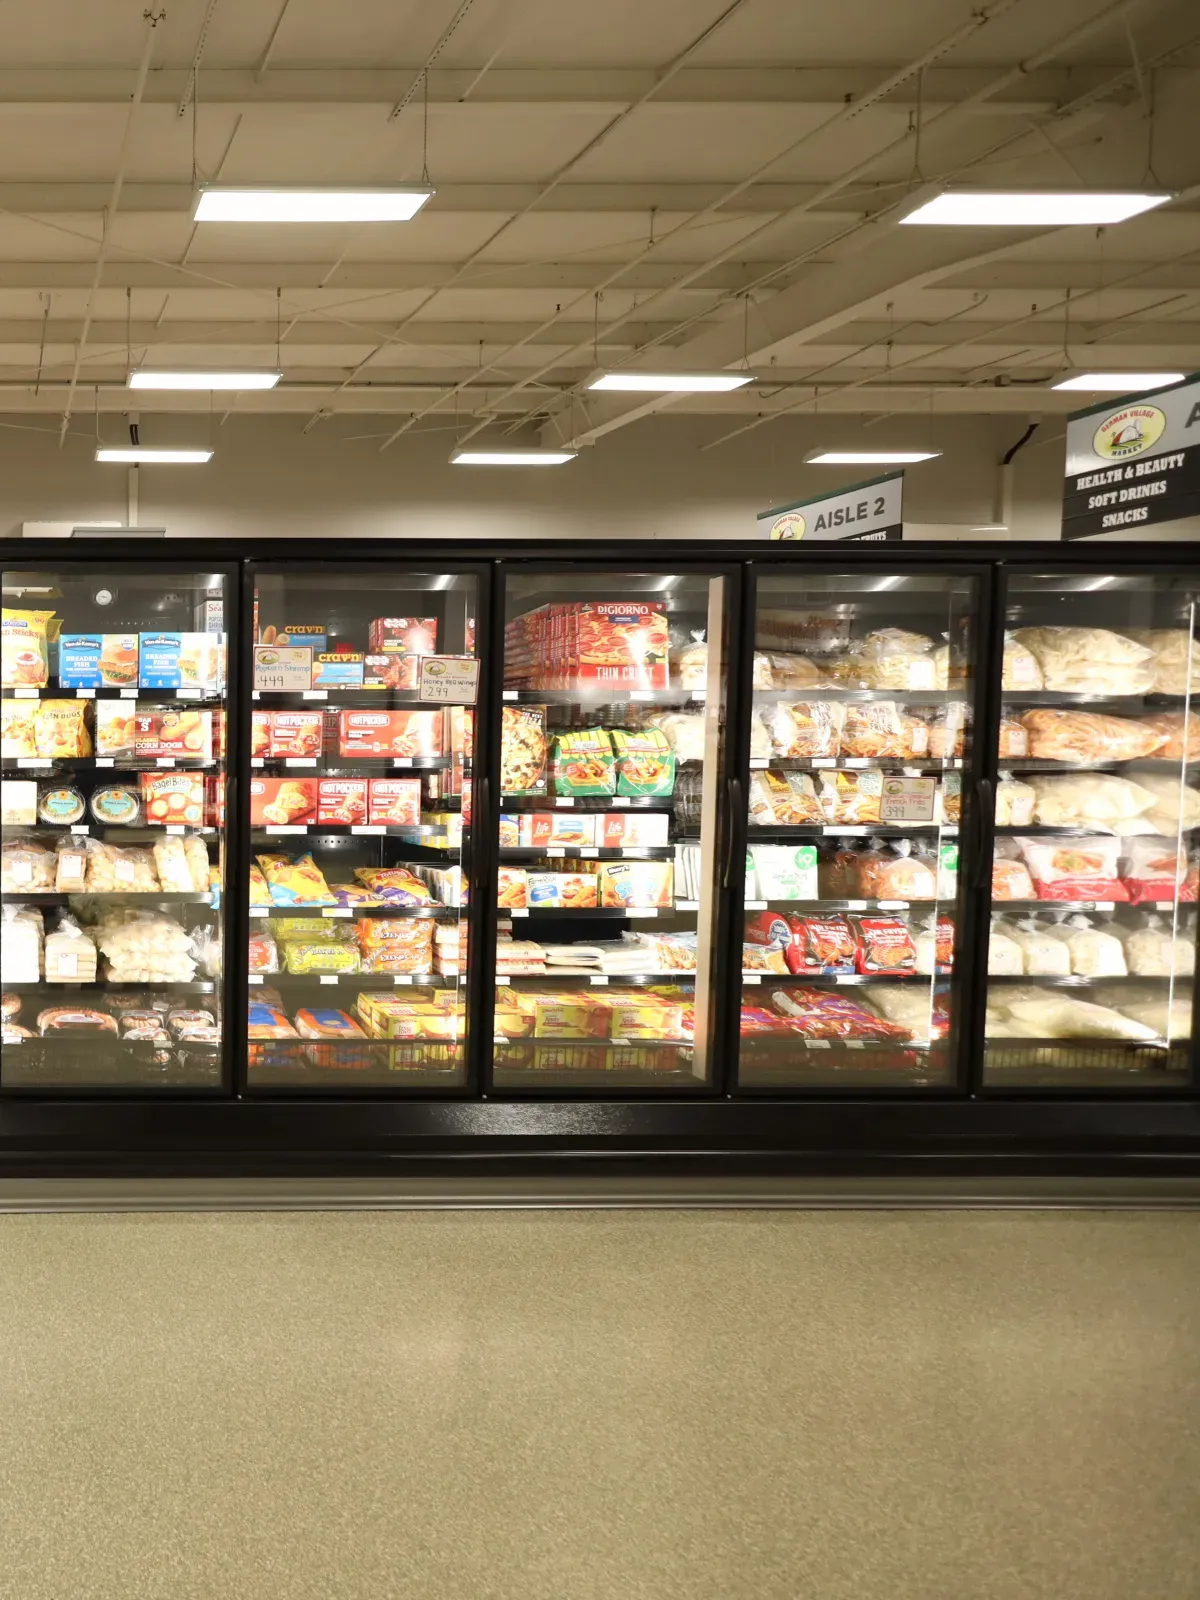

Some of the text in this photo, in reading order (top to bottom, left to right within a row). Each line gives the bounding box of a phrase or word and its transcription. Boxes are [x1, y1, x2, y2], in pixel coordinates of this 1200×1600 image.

[1101, 409, 1155, 433] GERMAN VILLAGE
[1111, 443, 1143, 457] MARKET
[1076, 453, 1186, 491] HEALTH & BEAUTY
[1088, 480, 1168, 509] SOFT DRINKS
[813, 496, 885, 532] AISLE 2
[1102, 506, 1149, 528] SNACKS
[12, 628, 40, 638] Sticks
[256, 664, 311, 673] Popcorn Shrimp
[596, 667, 619, 681] THIN
[151, 777, 190, 791] Bagel Bites
[536, 821, 549, 835] Life
[607, 821, 622, 835] Life
